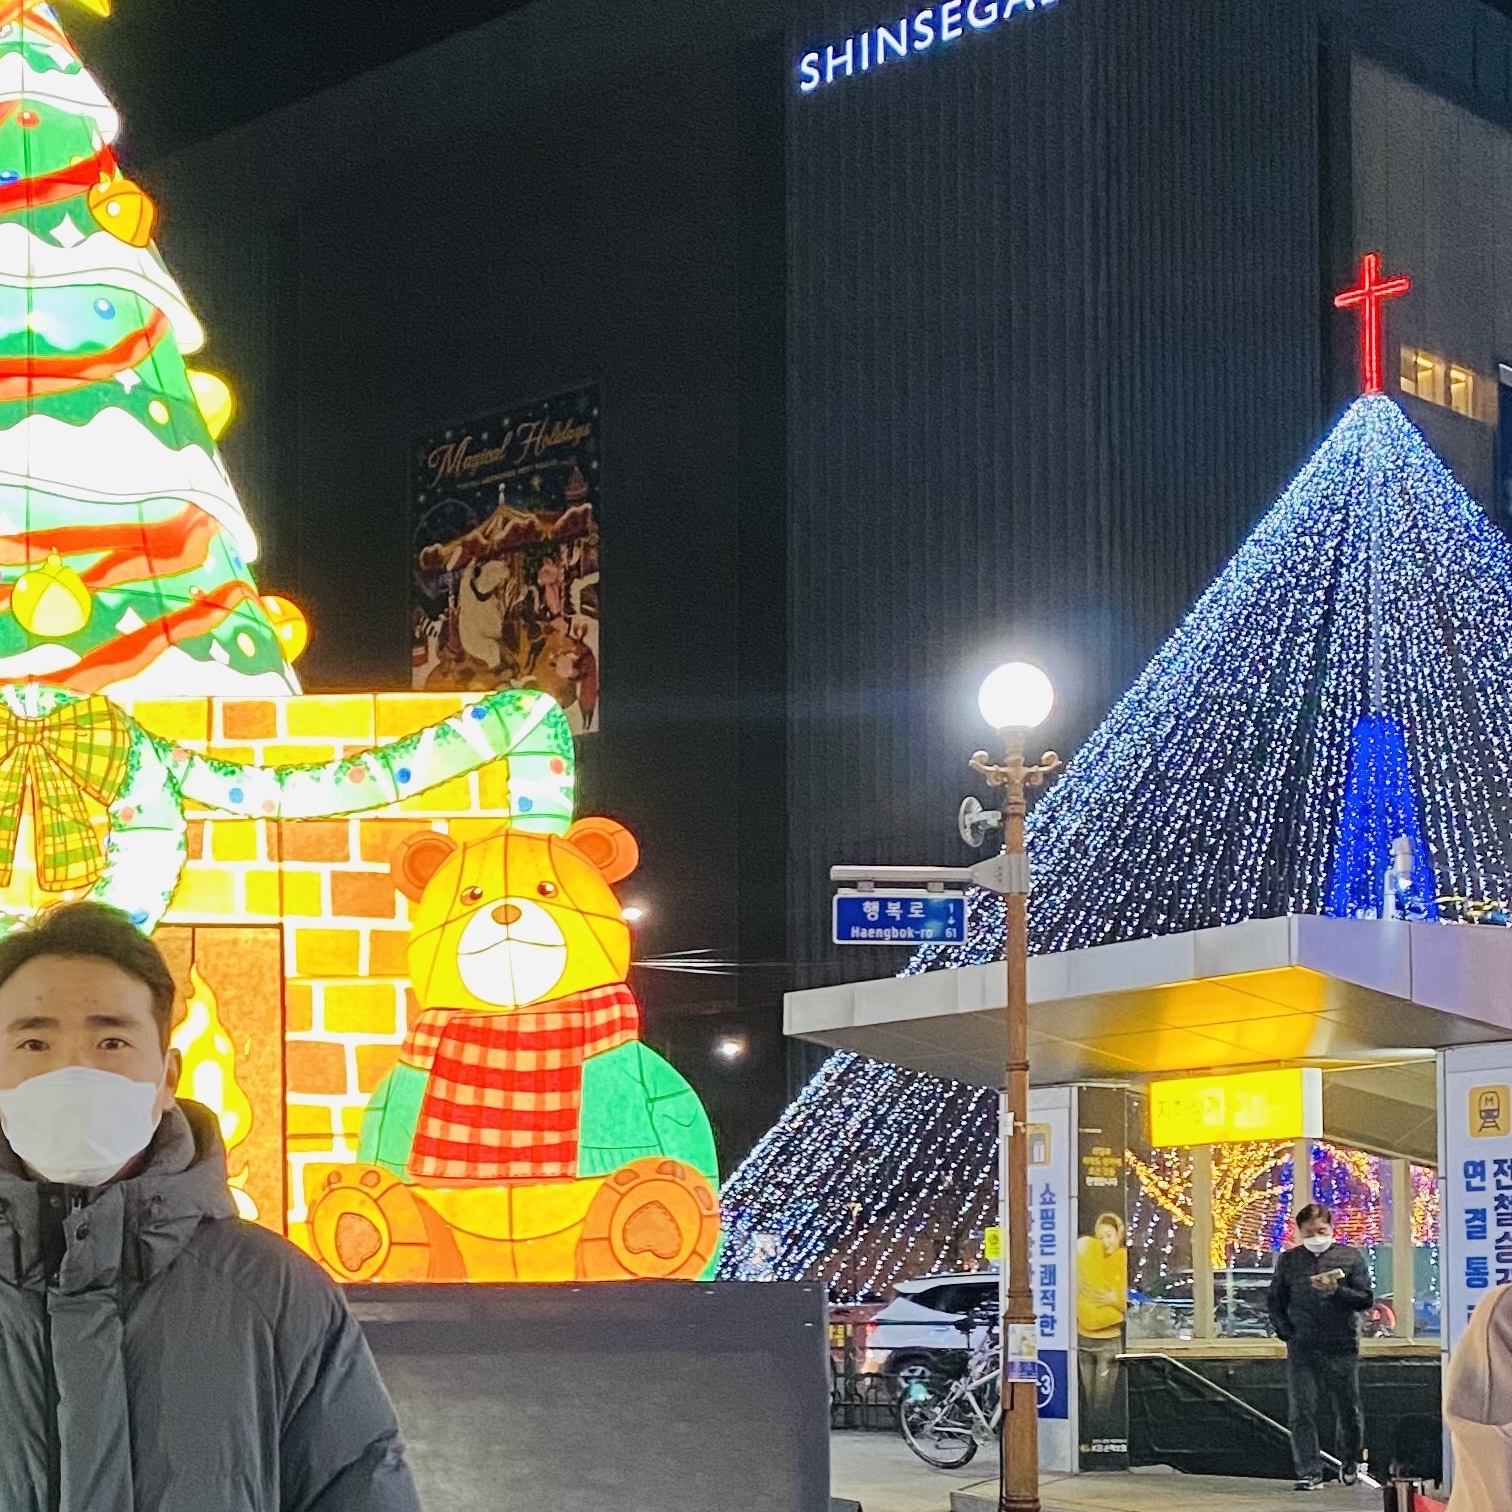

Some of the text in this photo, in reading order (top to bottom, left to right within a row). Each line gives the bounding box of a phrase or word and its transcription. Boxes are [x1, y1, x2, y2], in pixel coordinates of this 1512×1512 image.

[800, 0, 1059, 92] SHINSEGA
[515, 417, 591, 464] Holidays
[850, 925, 934, 941] Haengbok-ro
[861, 900, 927, 922] 행복로
[944, 927, 958, 939] 61
[1039, 1182, 1058, 1338] 쇼핑은 쾌적한
[1463, 1160, 1489, 1325] 연결통
